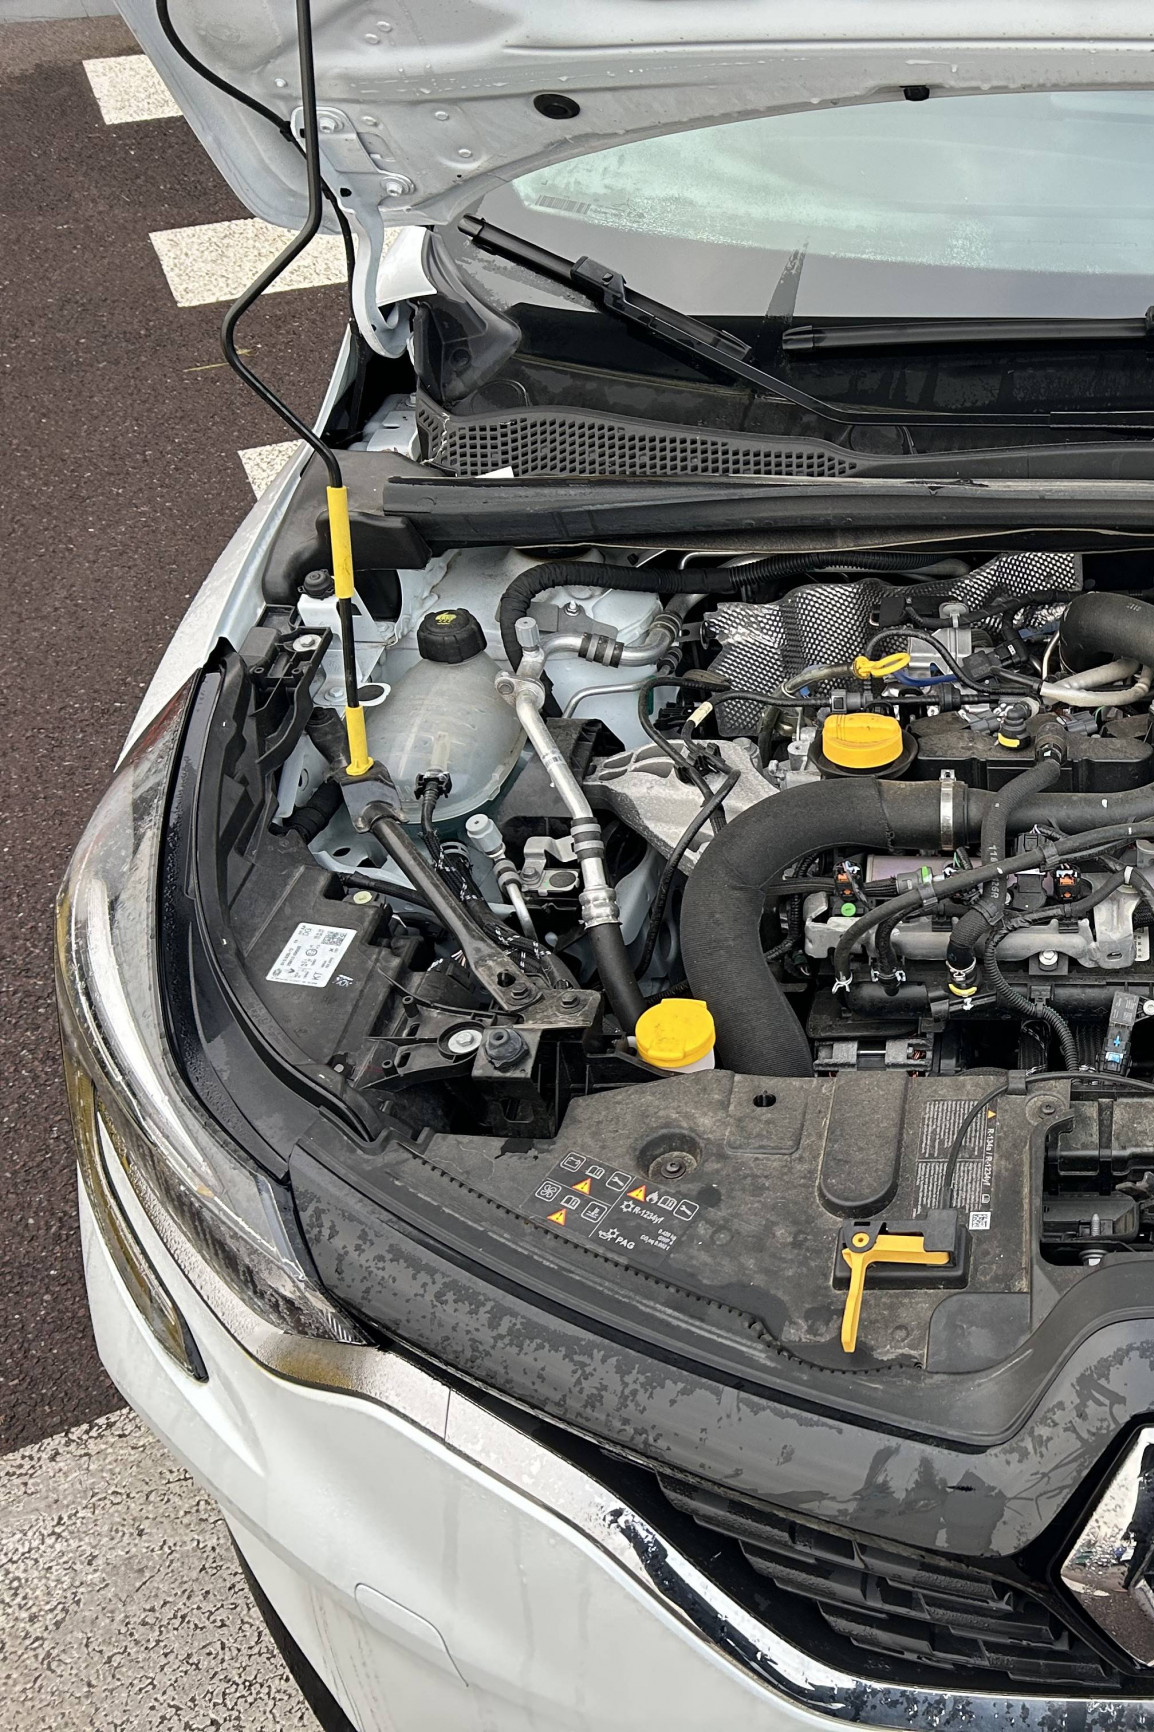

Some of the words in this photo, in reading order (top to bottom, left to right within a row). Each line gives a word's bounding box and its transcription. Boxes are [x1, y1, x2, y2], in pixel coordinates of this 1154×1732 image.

[986, 1128, 994, 1150] R-134a
[982, 1155, 993, 1186] R-1234yf
[633, 1207, 664, 1224] R-1234yf
[615, 1237, 635, 1249] PAG
